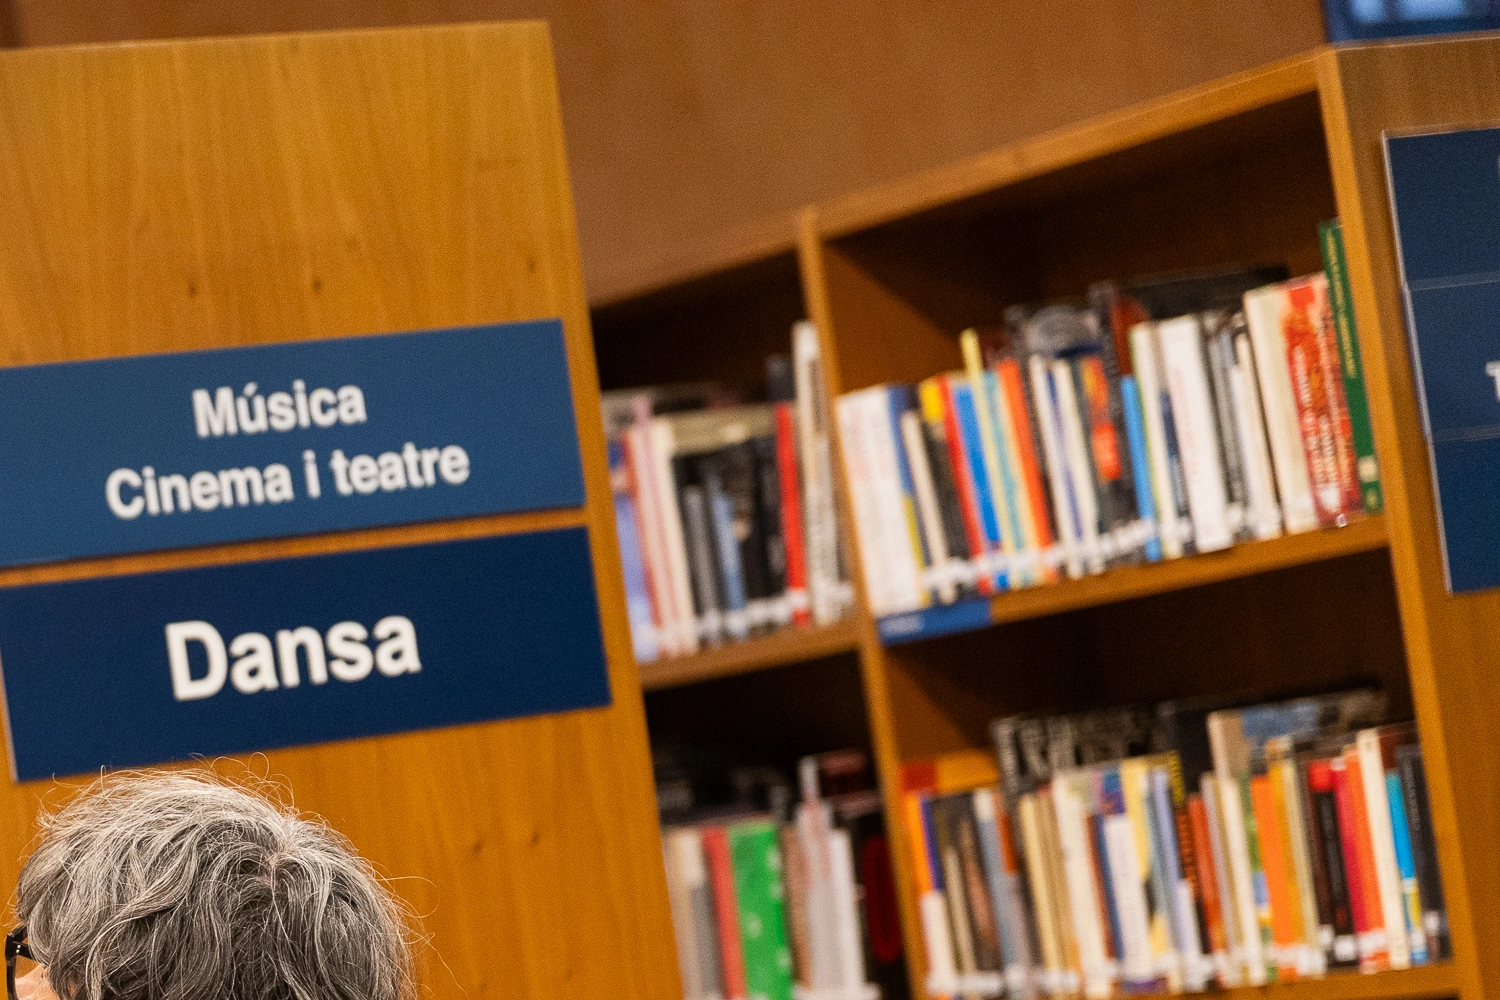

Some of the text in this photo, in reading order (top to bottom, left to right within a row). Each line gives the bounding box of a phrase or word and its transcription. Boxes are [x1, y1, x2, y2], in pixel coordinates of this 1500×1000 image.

[192, 379, 367, 438] Música
[106, 442, 471, 520] Cinema i teatre
[166, 614, 421, 702] Dansa
